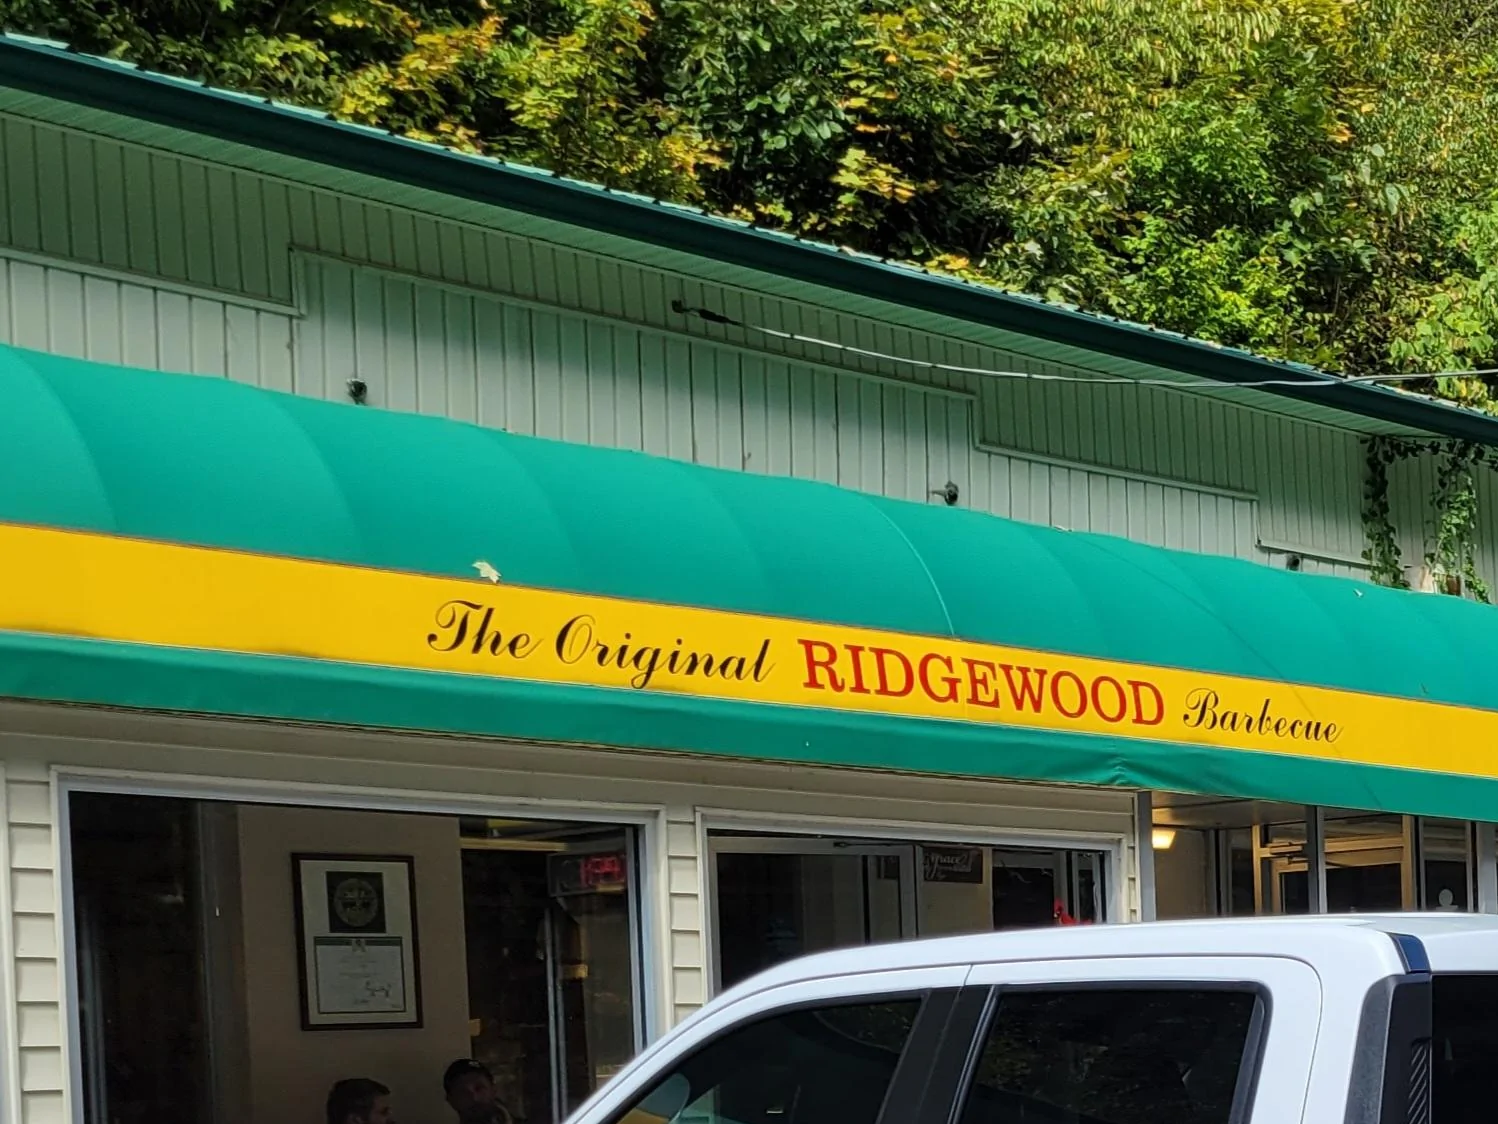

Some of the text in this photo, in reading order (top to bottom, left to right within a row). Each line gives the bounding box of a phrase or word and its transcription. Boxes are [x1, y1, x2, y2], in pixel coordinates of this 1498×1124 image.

[426, 599, 1344, 744] The Original RIDGEWOOD Barbecue
